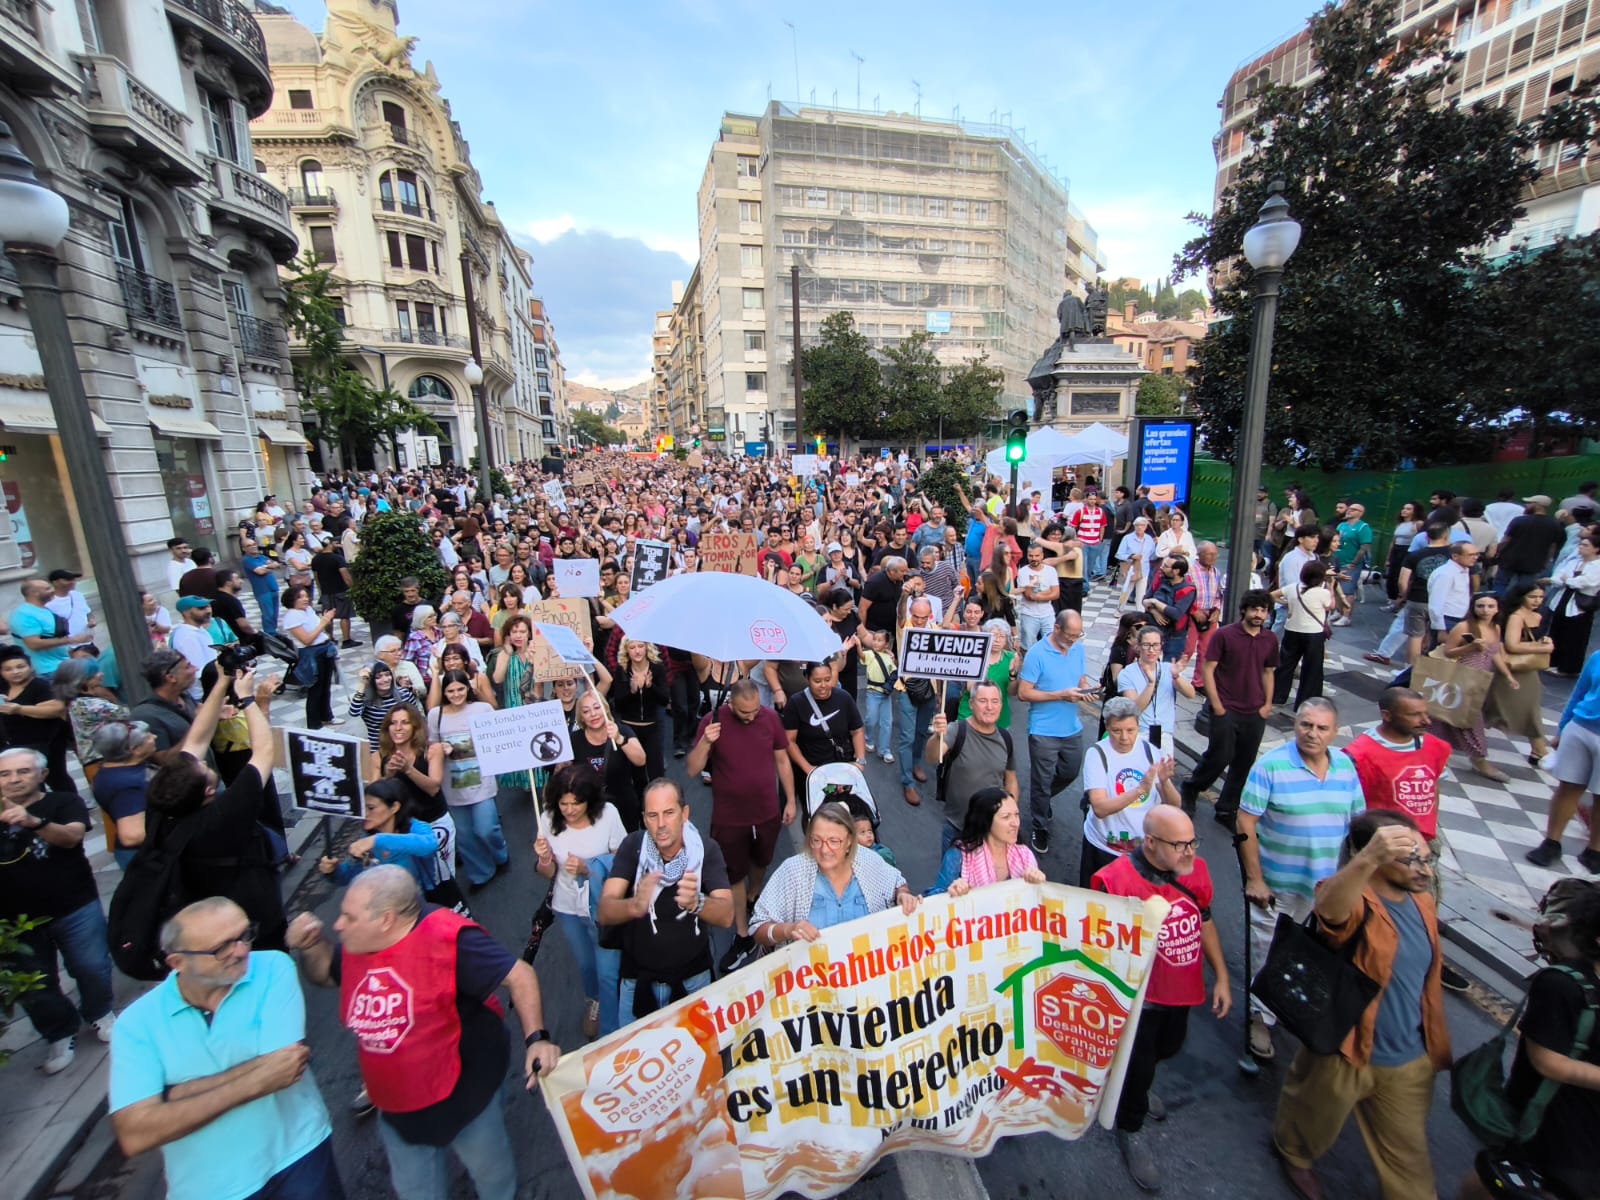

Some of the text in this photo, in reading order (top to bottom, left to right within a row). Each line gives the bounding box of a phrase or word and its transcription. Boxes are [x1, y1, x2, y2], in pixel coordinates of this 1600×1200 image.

[1145, 438, 1171, 446] ofertas
[1159, 429, 1187, 439] grandes
[1151, 456, 1177, 464] martes
[704, 534, 755, 550] IROS A
[703, 549, 756, 563] TOMAR POR
[753, 627, 781, 637] STOP
[910, 633, 985, 655] SE VENDE
[931, 654, 971, 665] derecho
[939, 667, 969, 675] techo
[473, 706, 560, 729] Los fondos buitres
[518, 724, 527, 734] la
[530, 720, 550, 731] vida
[551, 717, 563, 727] de
[481, 740, 523, 754] la gente
[1158, 914, 1198, 940] STOP
[686, 904, 1142, 1045] Stop Desahucios Granada 15M
[353, 993, 403, 1018] STOP
[1041, 994, 1127, 1036] STOP
[718, 975, 956, 1080] La vivienda
[1042, 1015, 1118, 1046] Desahucio
[1053, 1029, 1115, 1057] Granada
[1070, 1046, 1098, 1064] 15 M
[593, 1039, 682, 1113] STOP
[726, 1020, 1004, 1124] es un derecho
[607, 1056, 695, 1124] Desahucios
[628, 1072, 693, 1123] Granada
[943, 1072, 1005, 1129] negocio
